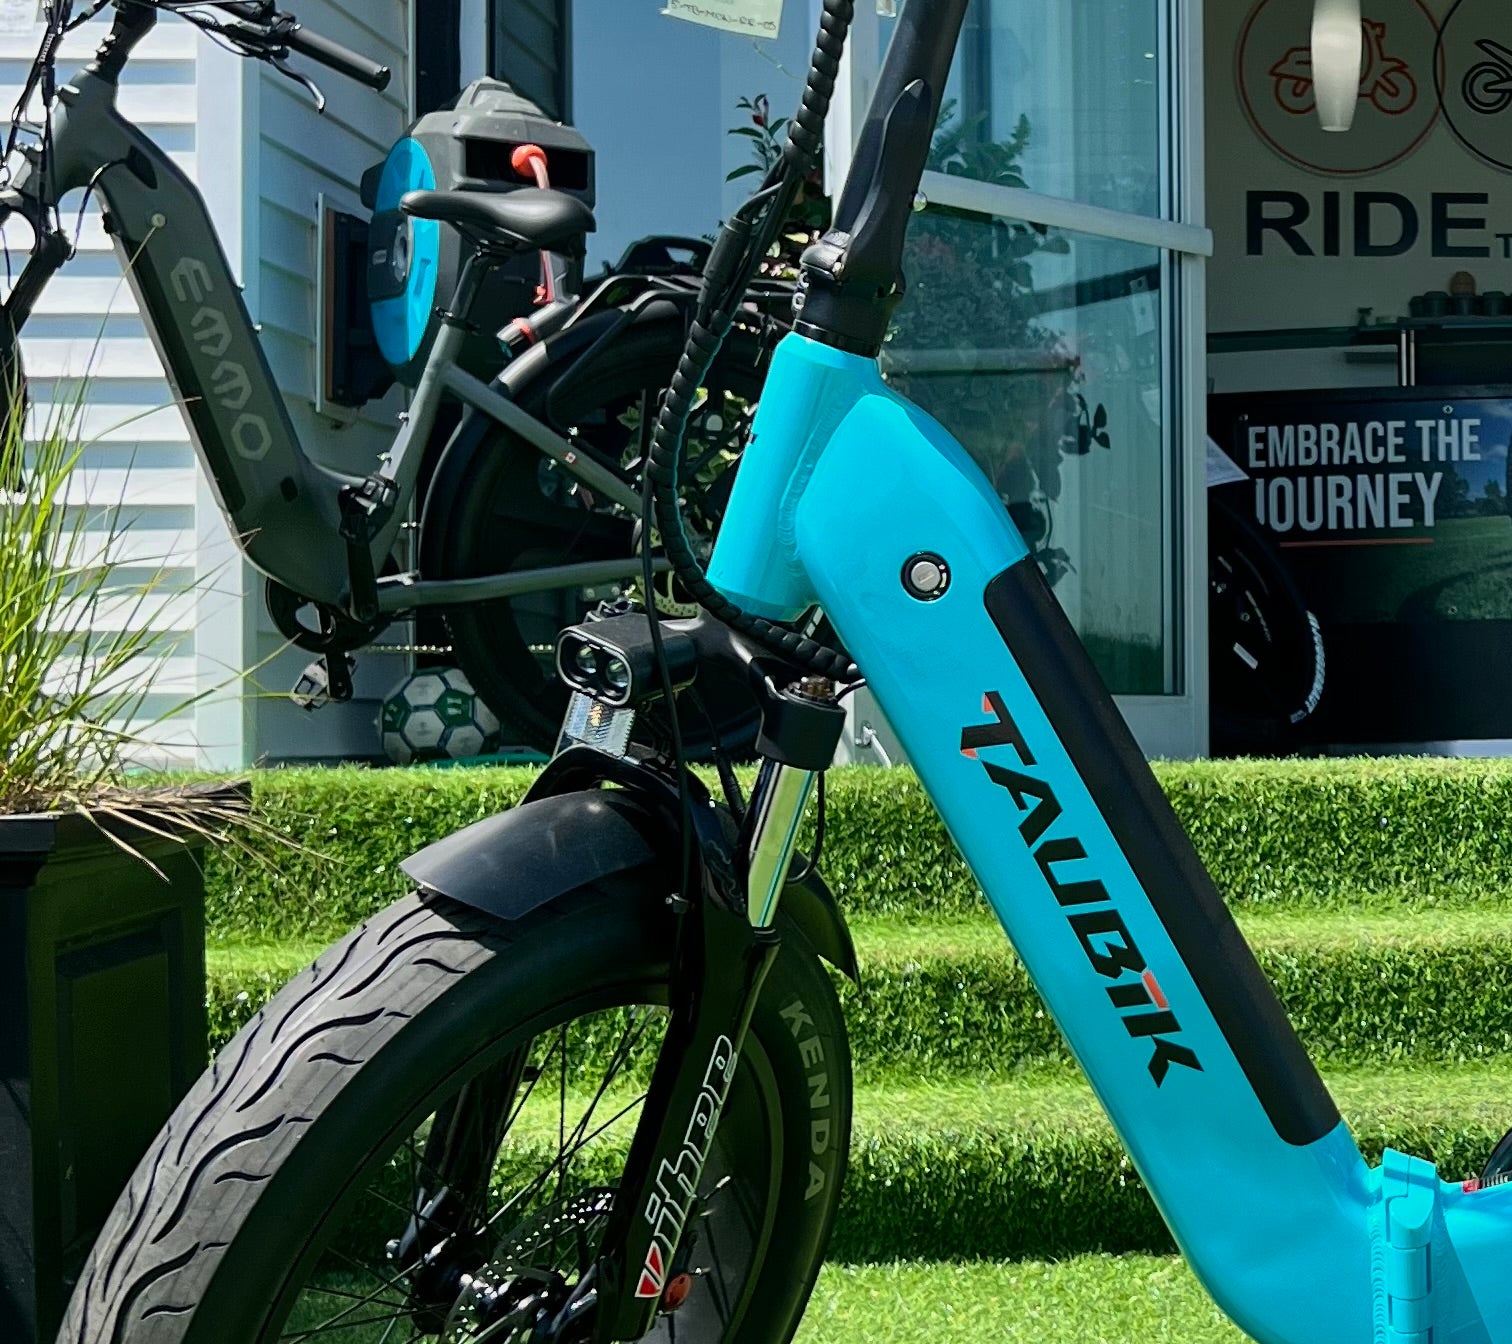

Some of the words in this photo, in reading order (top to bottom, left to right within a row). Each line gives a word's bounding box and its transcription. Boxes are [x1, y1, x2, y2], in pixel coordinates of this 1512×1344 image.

[1245, 190, 1492, 258] RIDE
[1247, 420, 1405, 469] EMBRACE
[1417, 418, 1482, 462] THE
[960, 690, 1205, 1089] TAUBIK
[779, 998, 832, 1202] KENDA
